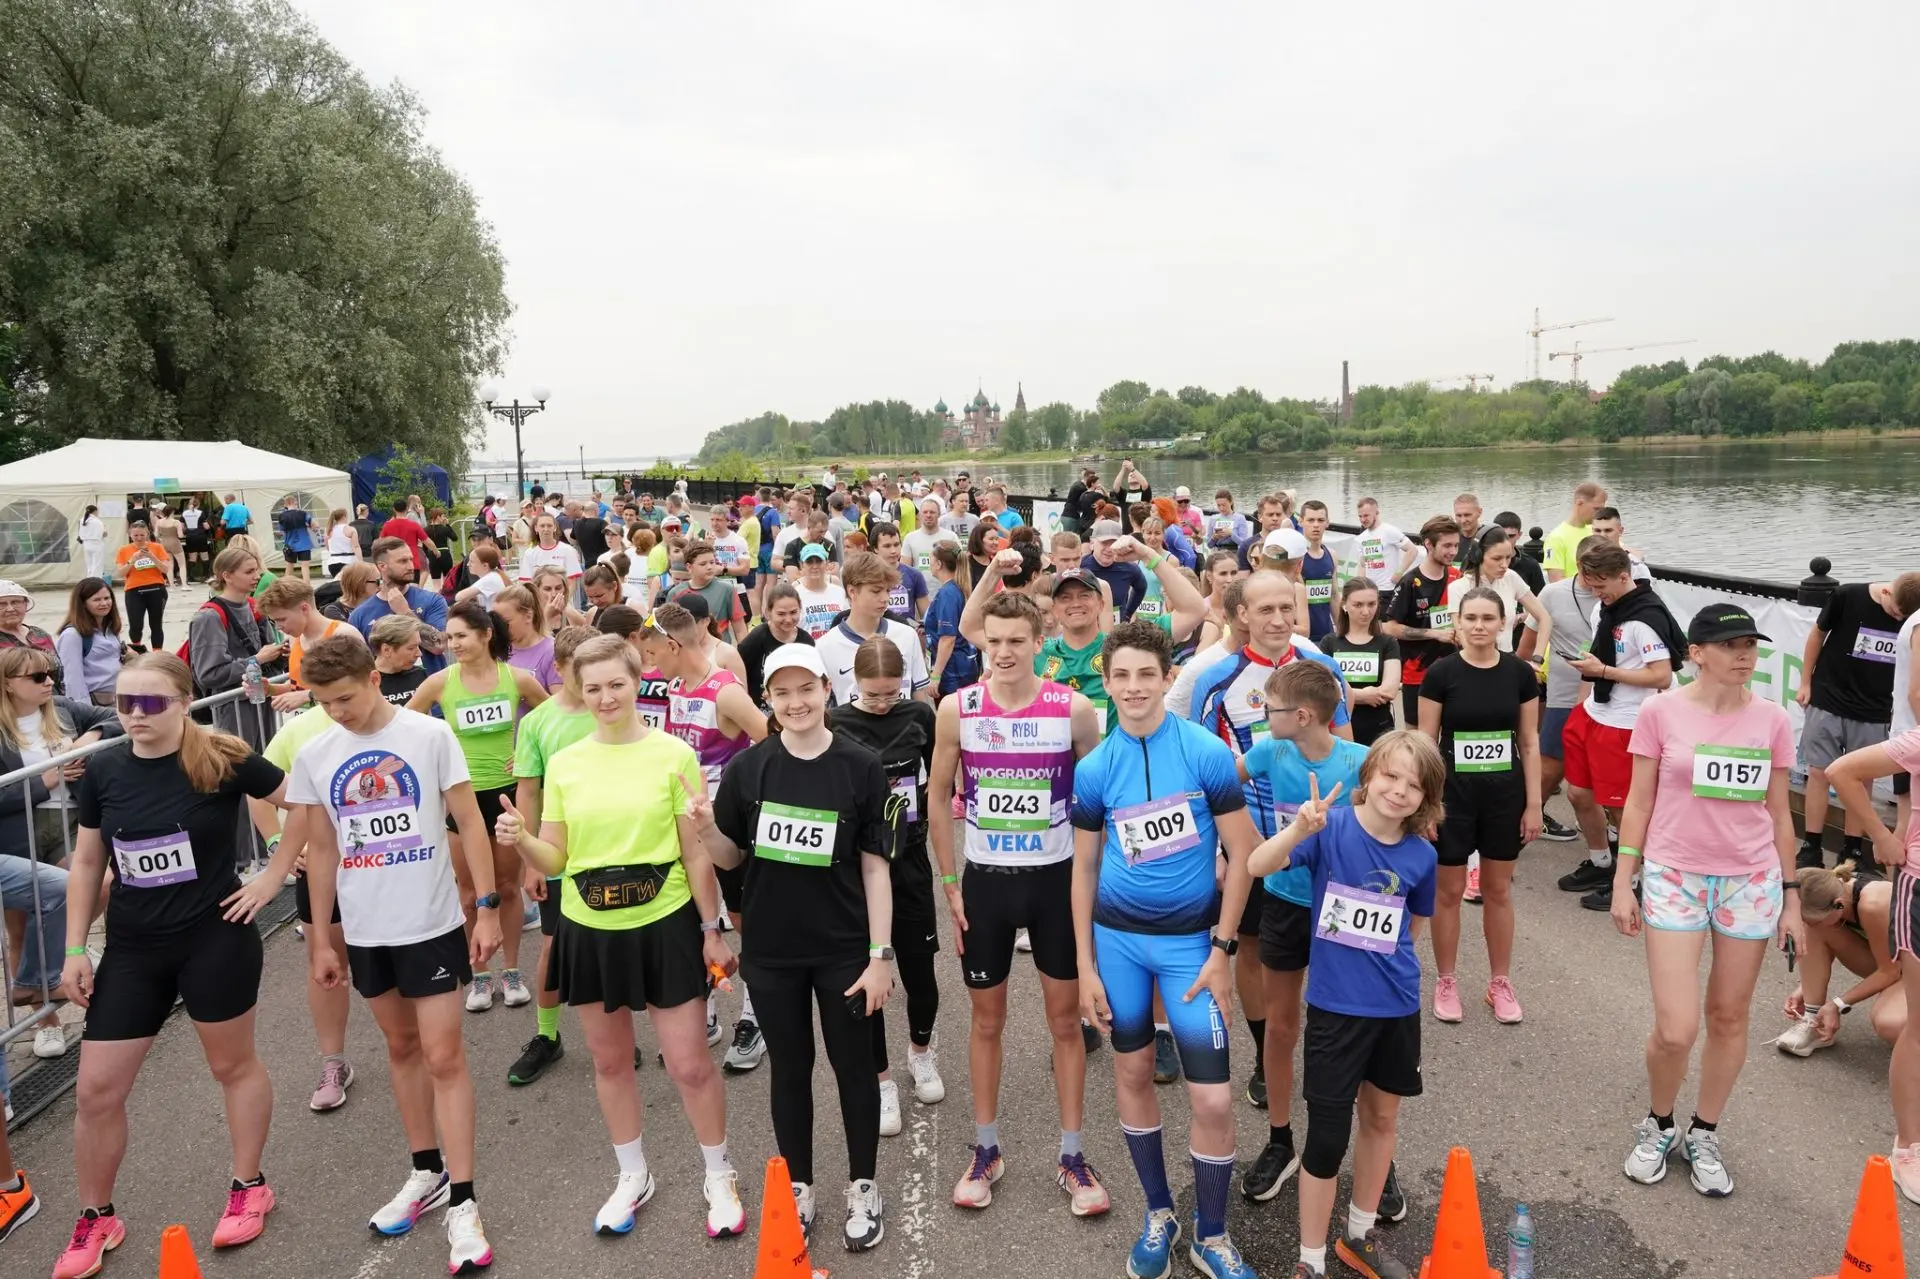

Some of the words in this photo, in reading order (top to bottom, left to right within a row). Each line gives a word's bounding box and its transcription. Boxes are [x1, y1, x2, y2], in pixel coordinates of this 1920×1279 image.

[1310, 587, 1329, 597] 0045
[1340, 660, 1372, 672] 0240
[1043, 692, 1070, 704] 005
[465, 705, 503, 724] 0121
[1011, 722, 1038, 738] RYBU
[1463, 743, 1504, 760] 0229
[1706, 761, 1762, 785] 0157
[988, 793, 1039, 815] 0243
[370, 813, 411, 837] 003
[768, 821, 823, 848] 0145
[1144, 812, 1185, 841] 009
[986, 833, 1044, 852] VEKA
[138, 849, 183, 873] 001
[340, 846, 436, 869] БОКСЗАБЕГ
[587, 878, 657, 907] БЕГИ
[1352, 908, 1393, 935] 016
